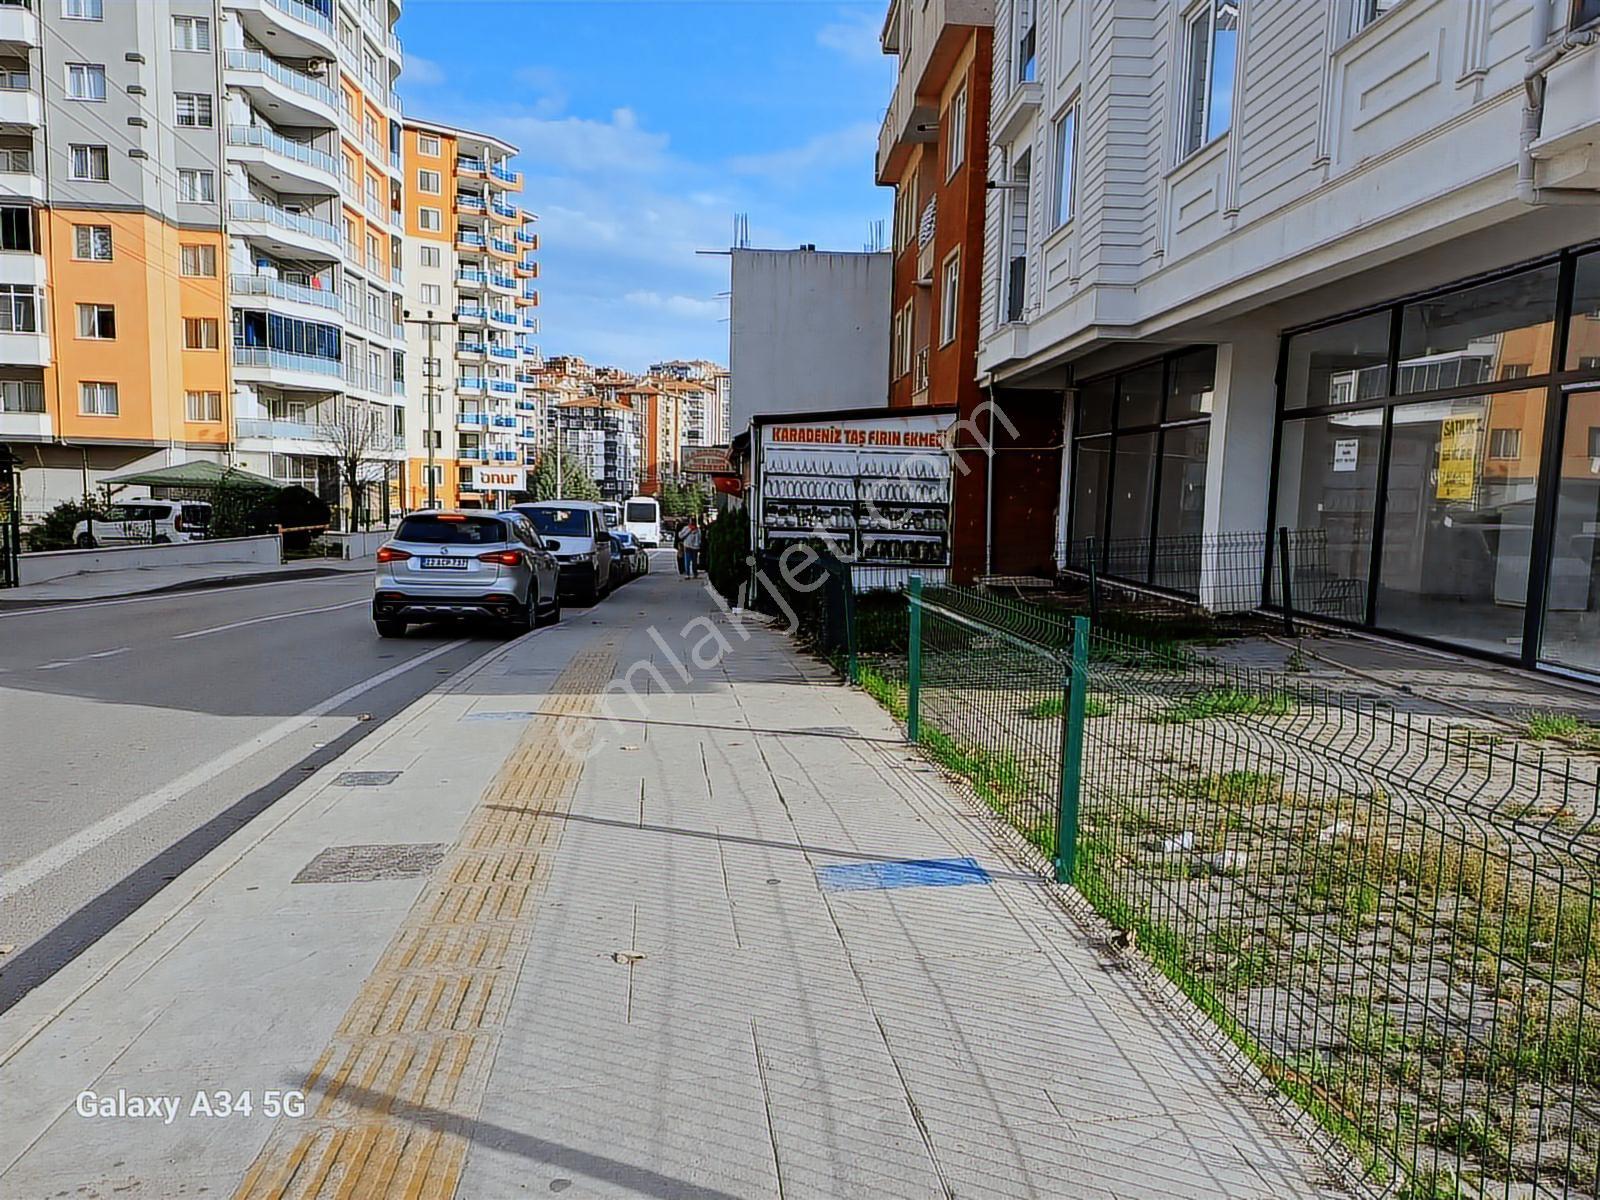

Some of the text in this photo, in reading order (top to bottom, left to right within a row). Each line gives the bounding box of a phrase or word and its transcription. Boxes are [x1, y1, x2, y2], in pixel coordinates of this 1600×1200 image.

[772, 426, 842, 444] KARADENİZ
[844, 430, 865, 447] TAŞ
[480, 471, 518, 484] onur
